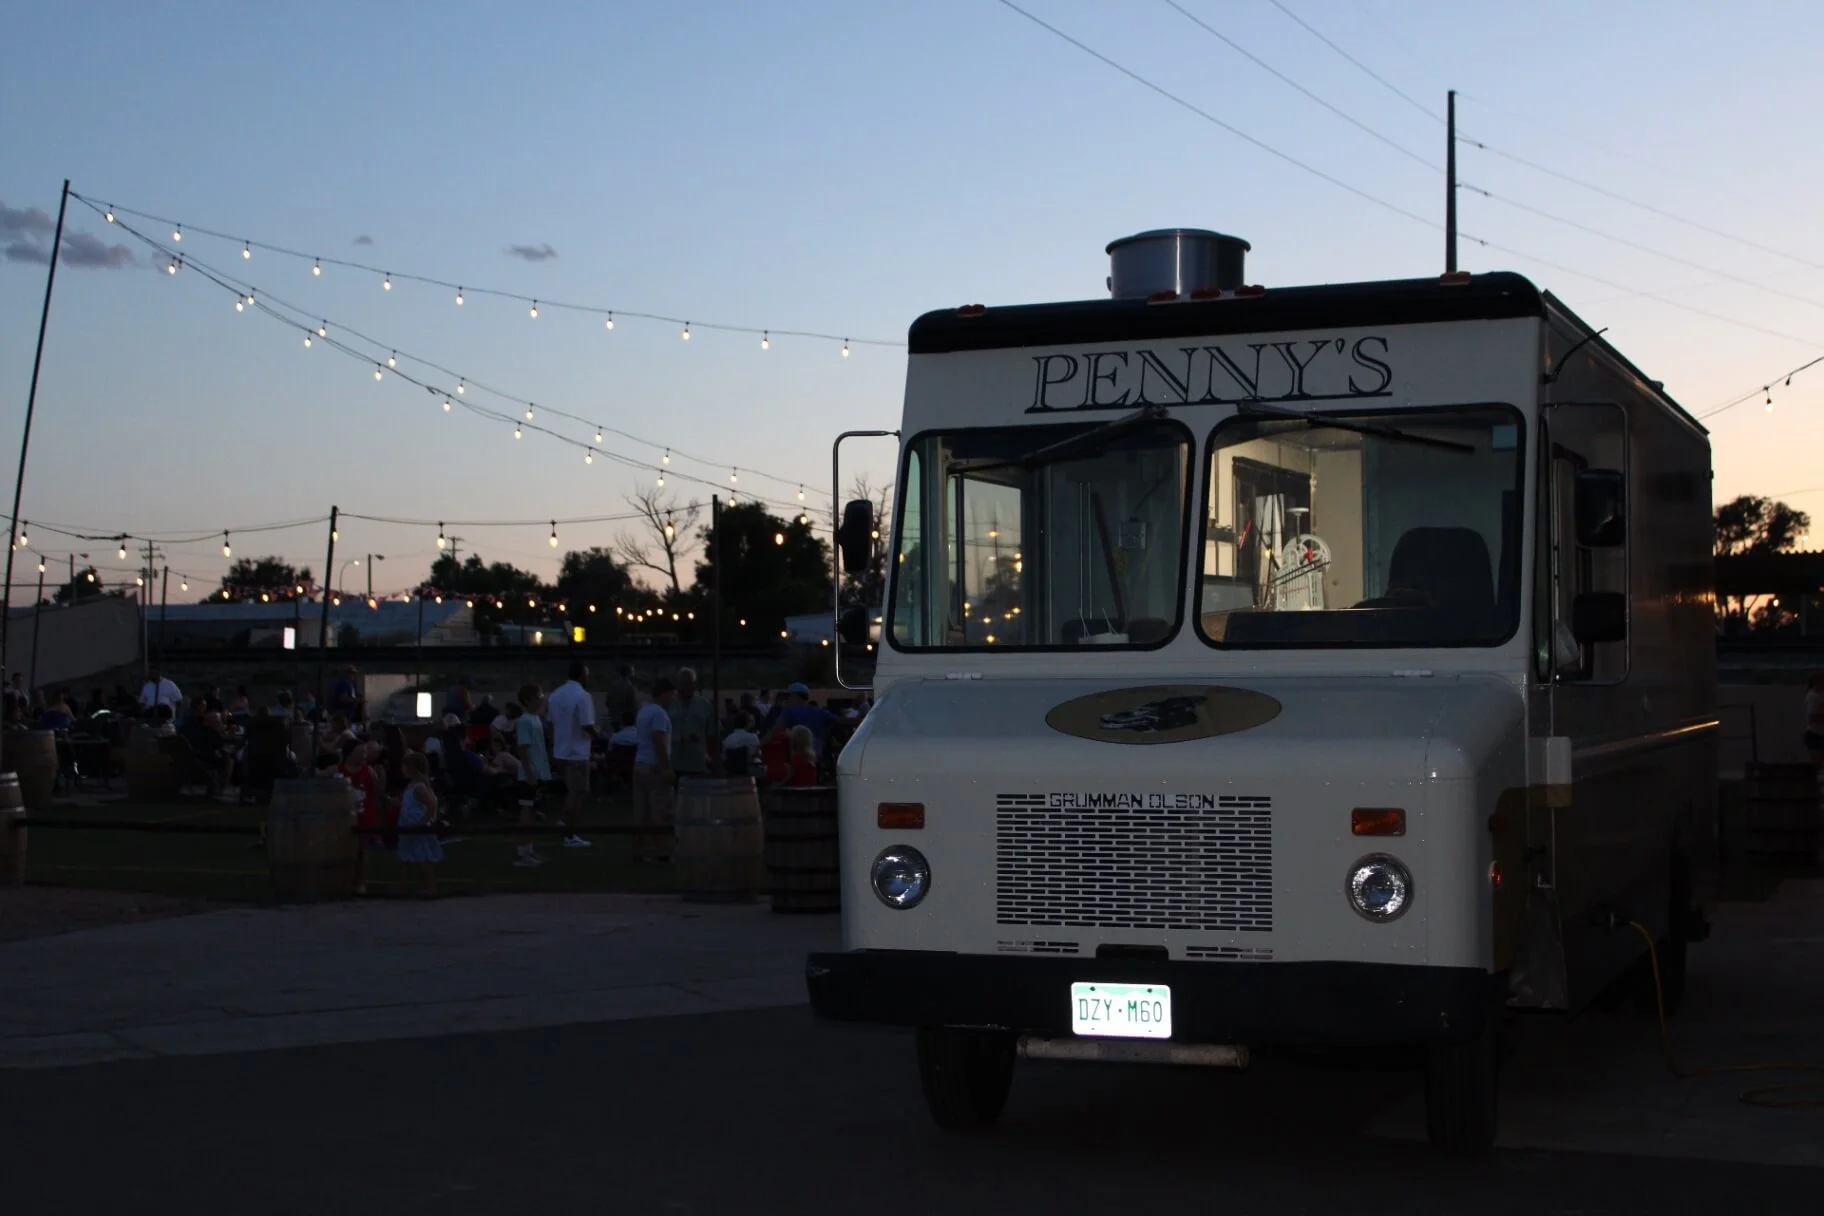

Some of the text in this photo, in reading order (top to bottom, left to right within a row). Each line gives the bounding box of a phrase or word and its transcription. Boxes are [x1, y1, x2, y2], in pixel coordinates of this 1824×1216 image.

[1031, 336, 1392, 409] PENNY'S
[1049, 792, 1215, 809] GRUMMAN OLSON
